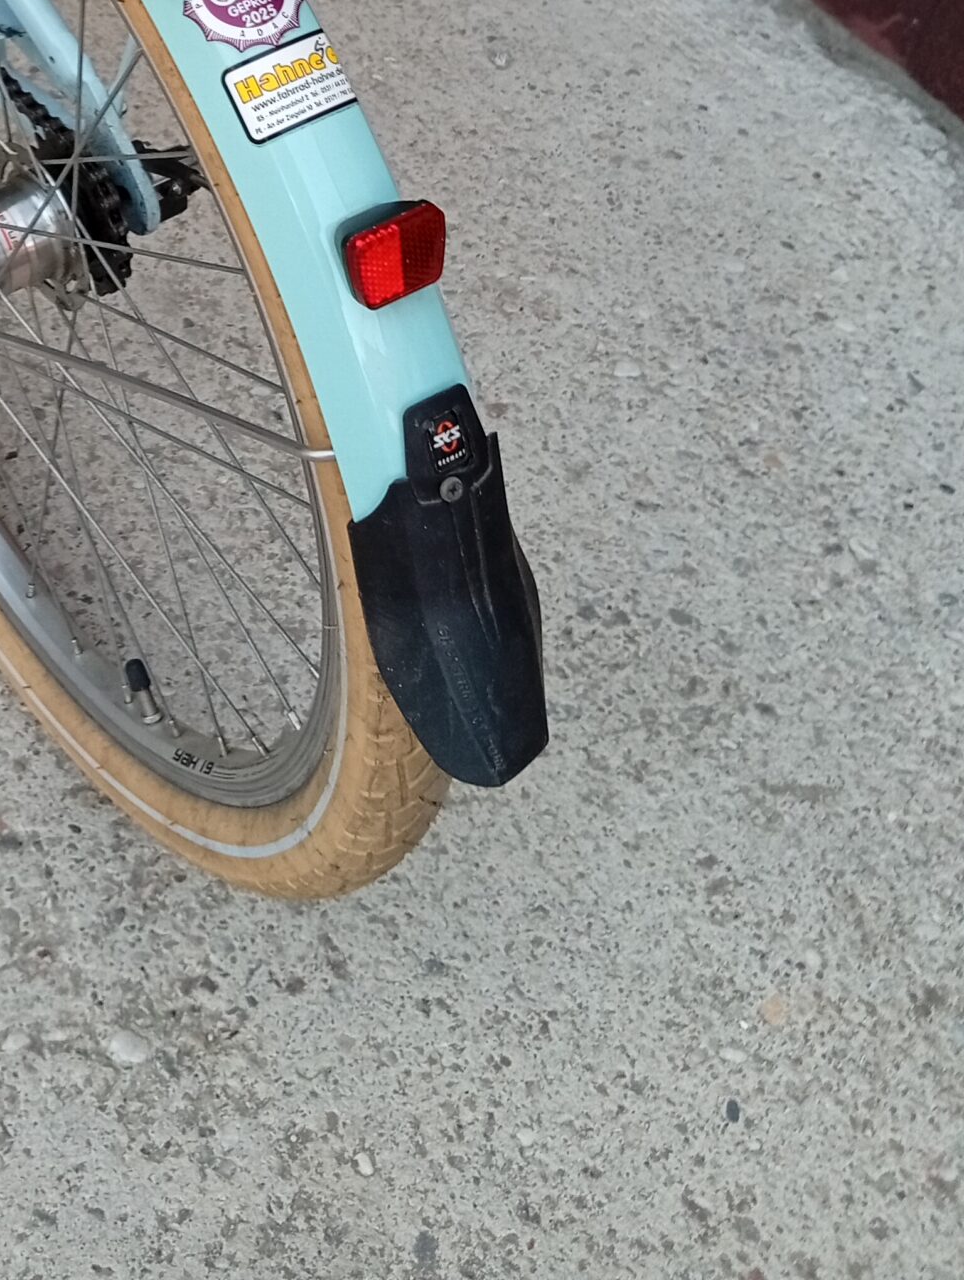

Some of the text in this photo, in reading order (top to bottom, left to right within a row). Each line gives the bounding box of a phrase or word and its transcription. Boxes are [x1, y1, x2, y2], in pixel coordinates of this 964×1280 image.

[239, 11, 289, 38] ADAC
[241, 4, 277, 27] 2025
[433, 424, 461, 449] SKS
